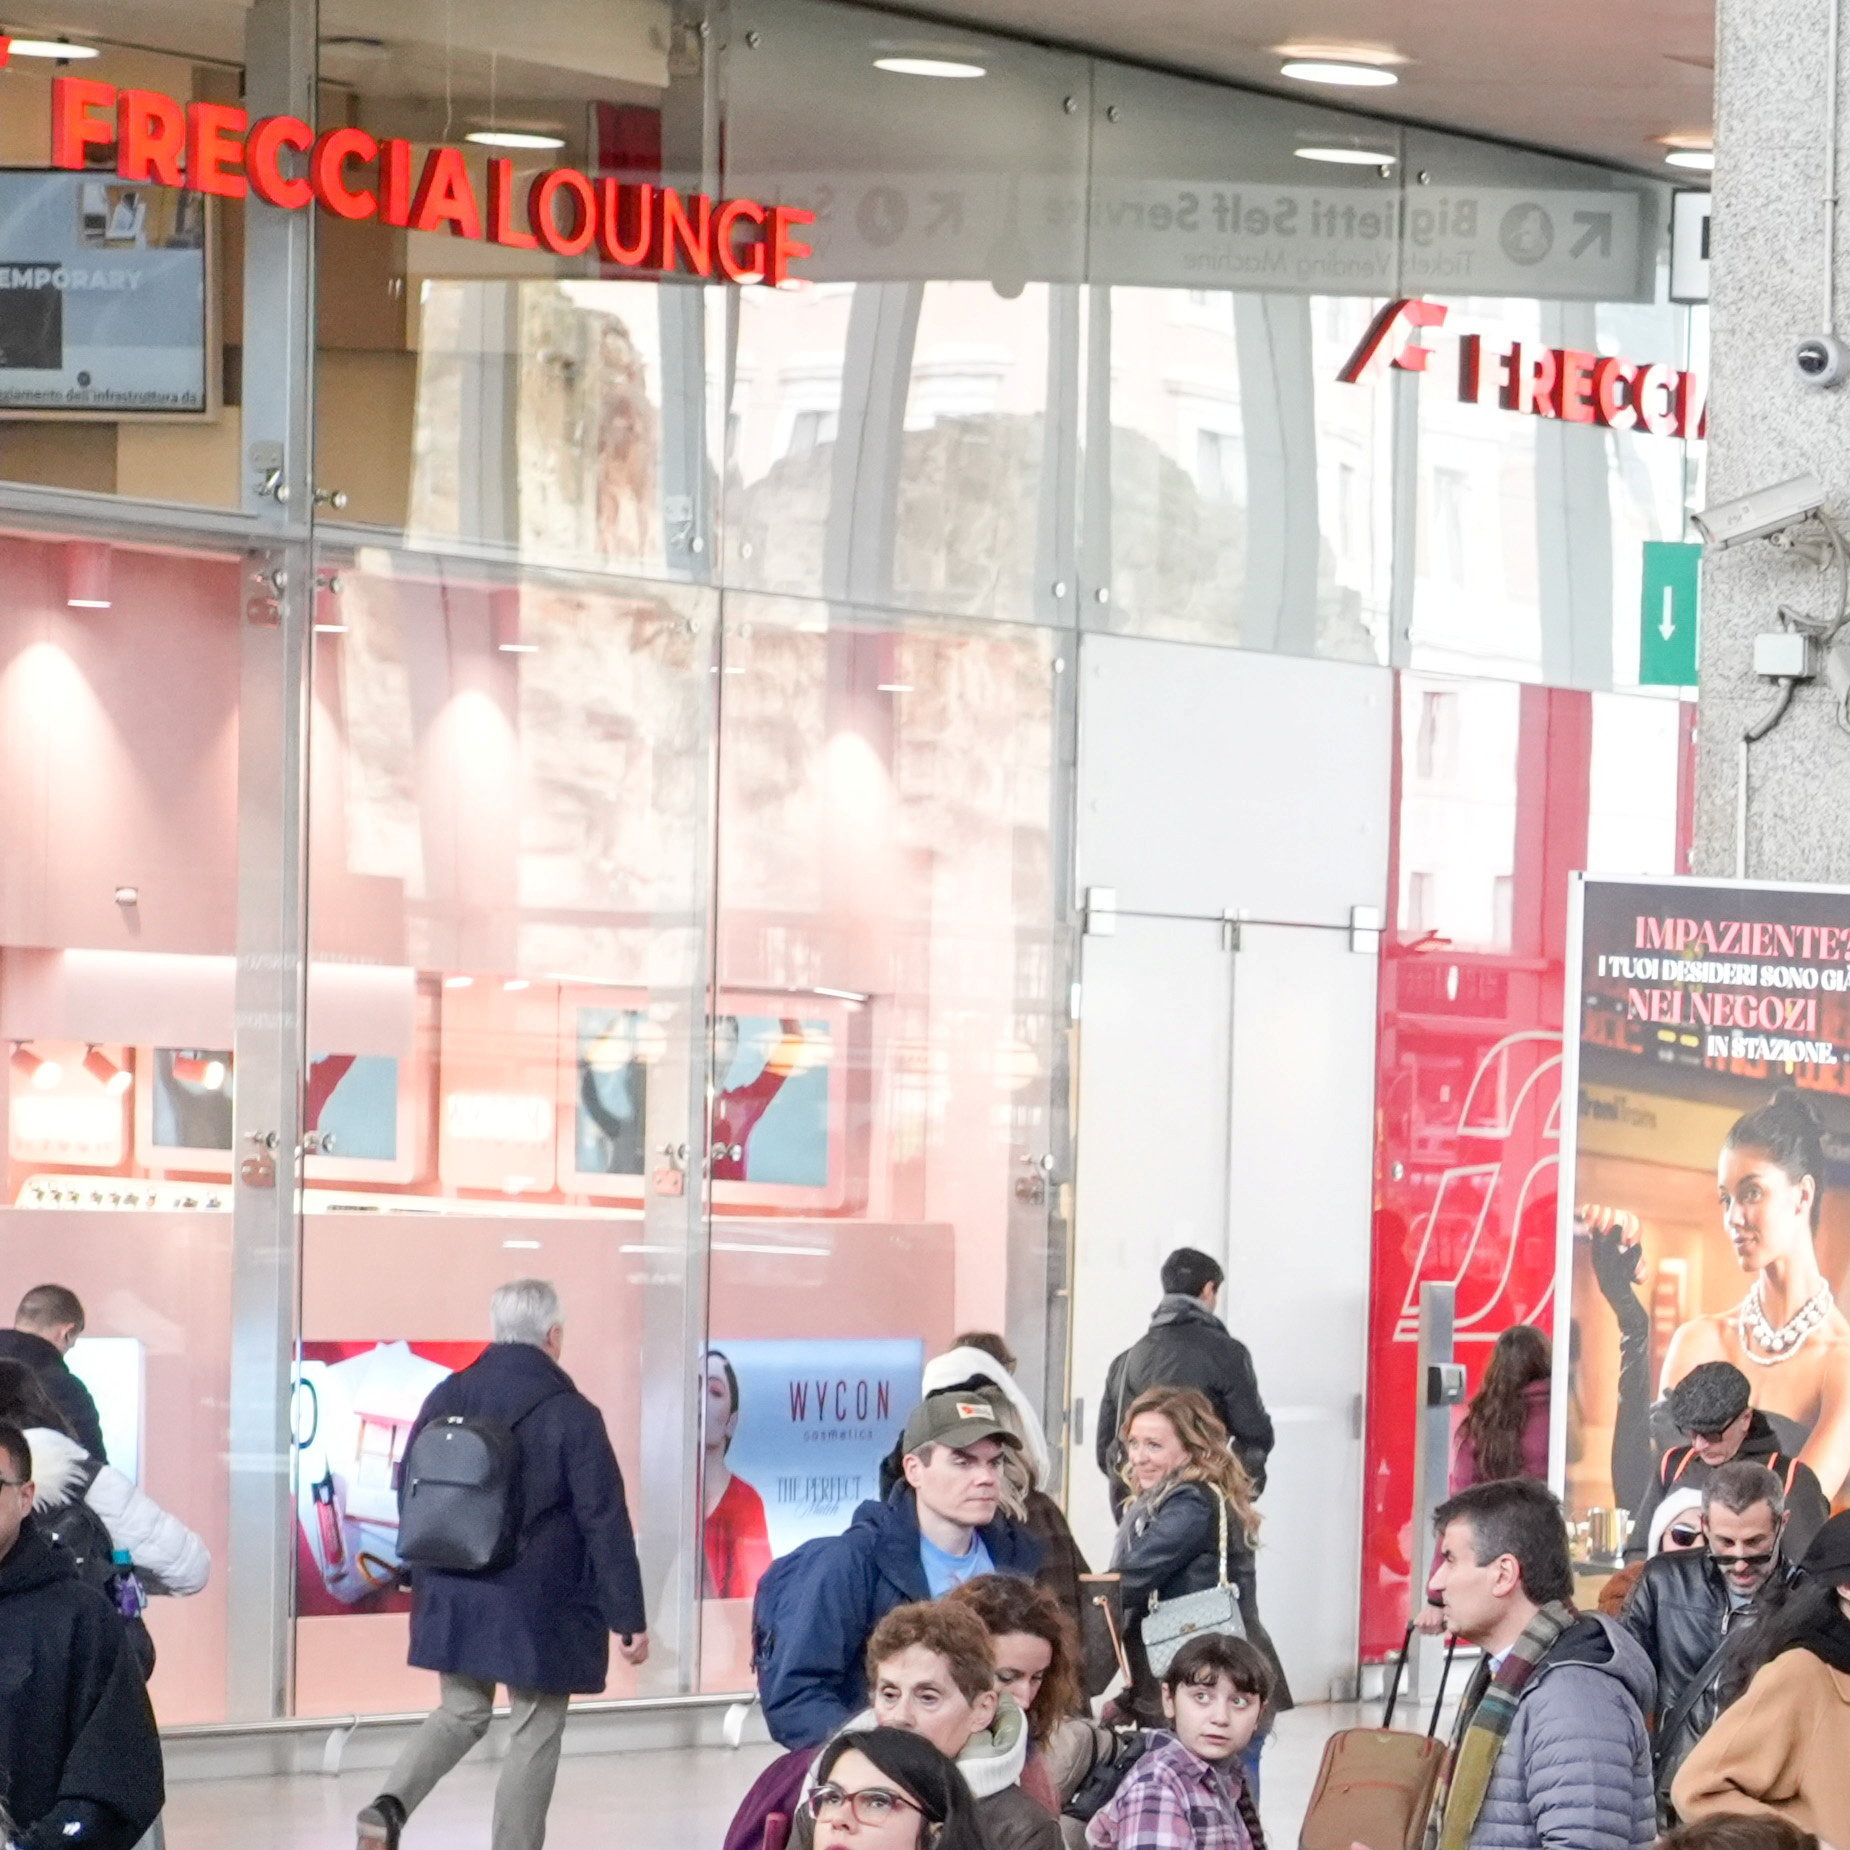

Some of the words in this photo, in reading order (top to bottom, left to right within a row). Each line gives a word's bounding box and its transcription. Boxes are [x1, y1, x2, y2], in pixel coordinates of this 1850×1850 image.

[1598, 955, 1606, 977] I
[1609, 956, 1659, 980] TUOI
[1662, 959, 1758, 987] DESIDERI
[1760, 964, 1819, 989] SONO
[1627, 987, 1683, 1023] NEI
[1689, 991, 1818, 1032] NEGOZI
[1707, 1035, 1730, 1057] IN
[789, 1380, 890, 1422] WYCON
